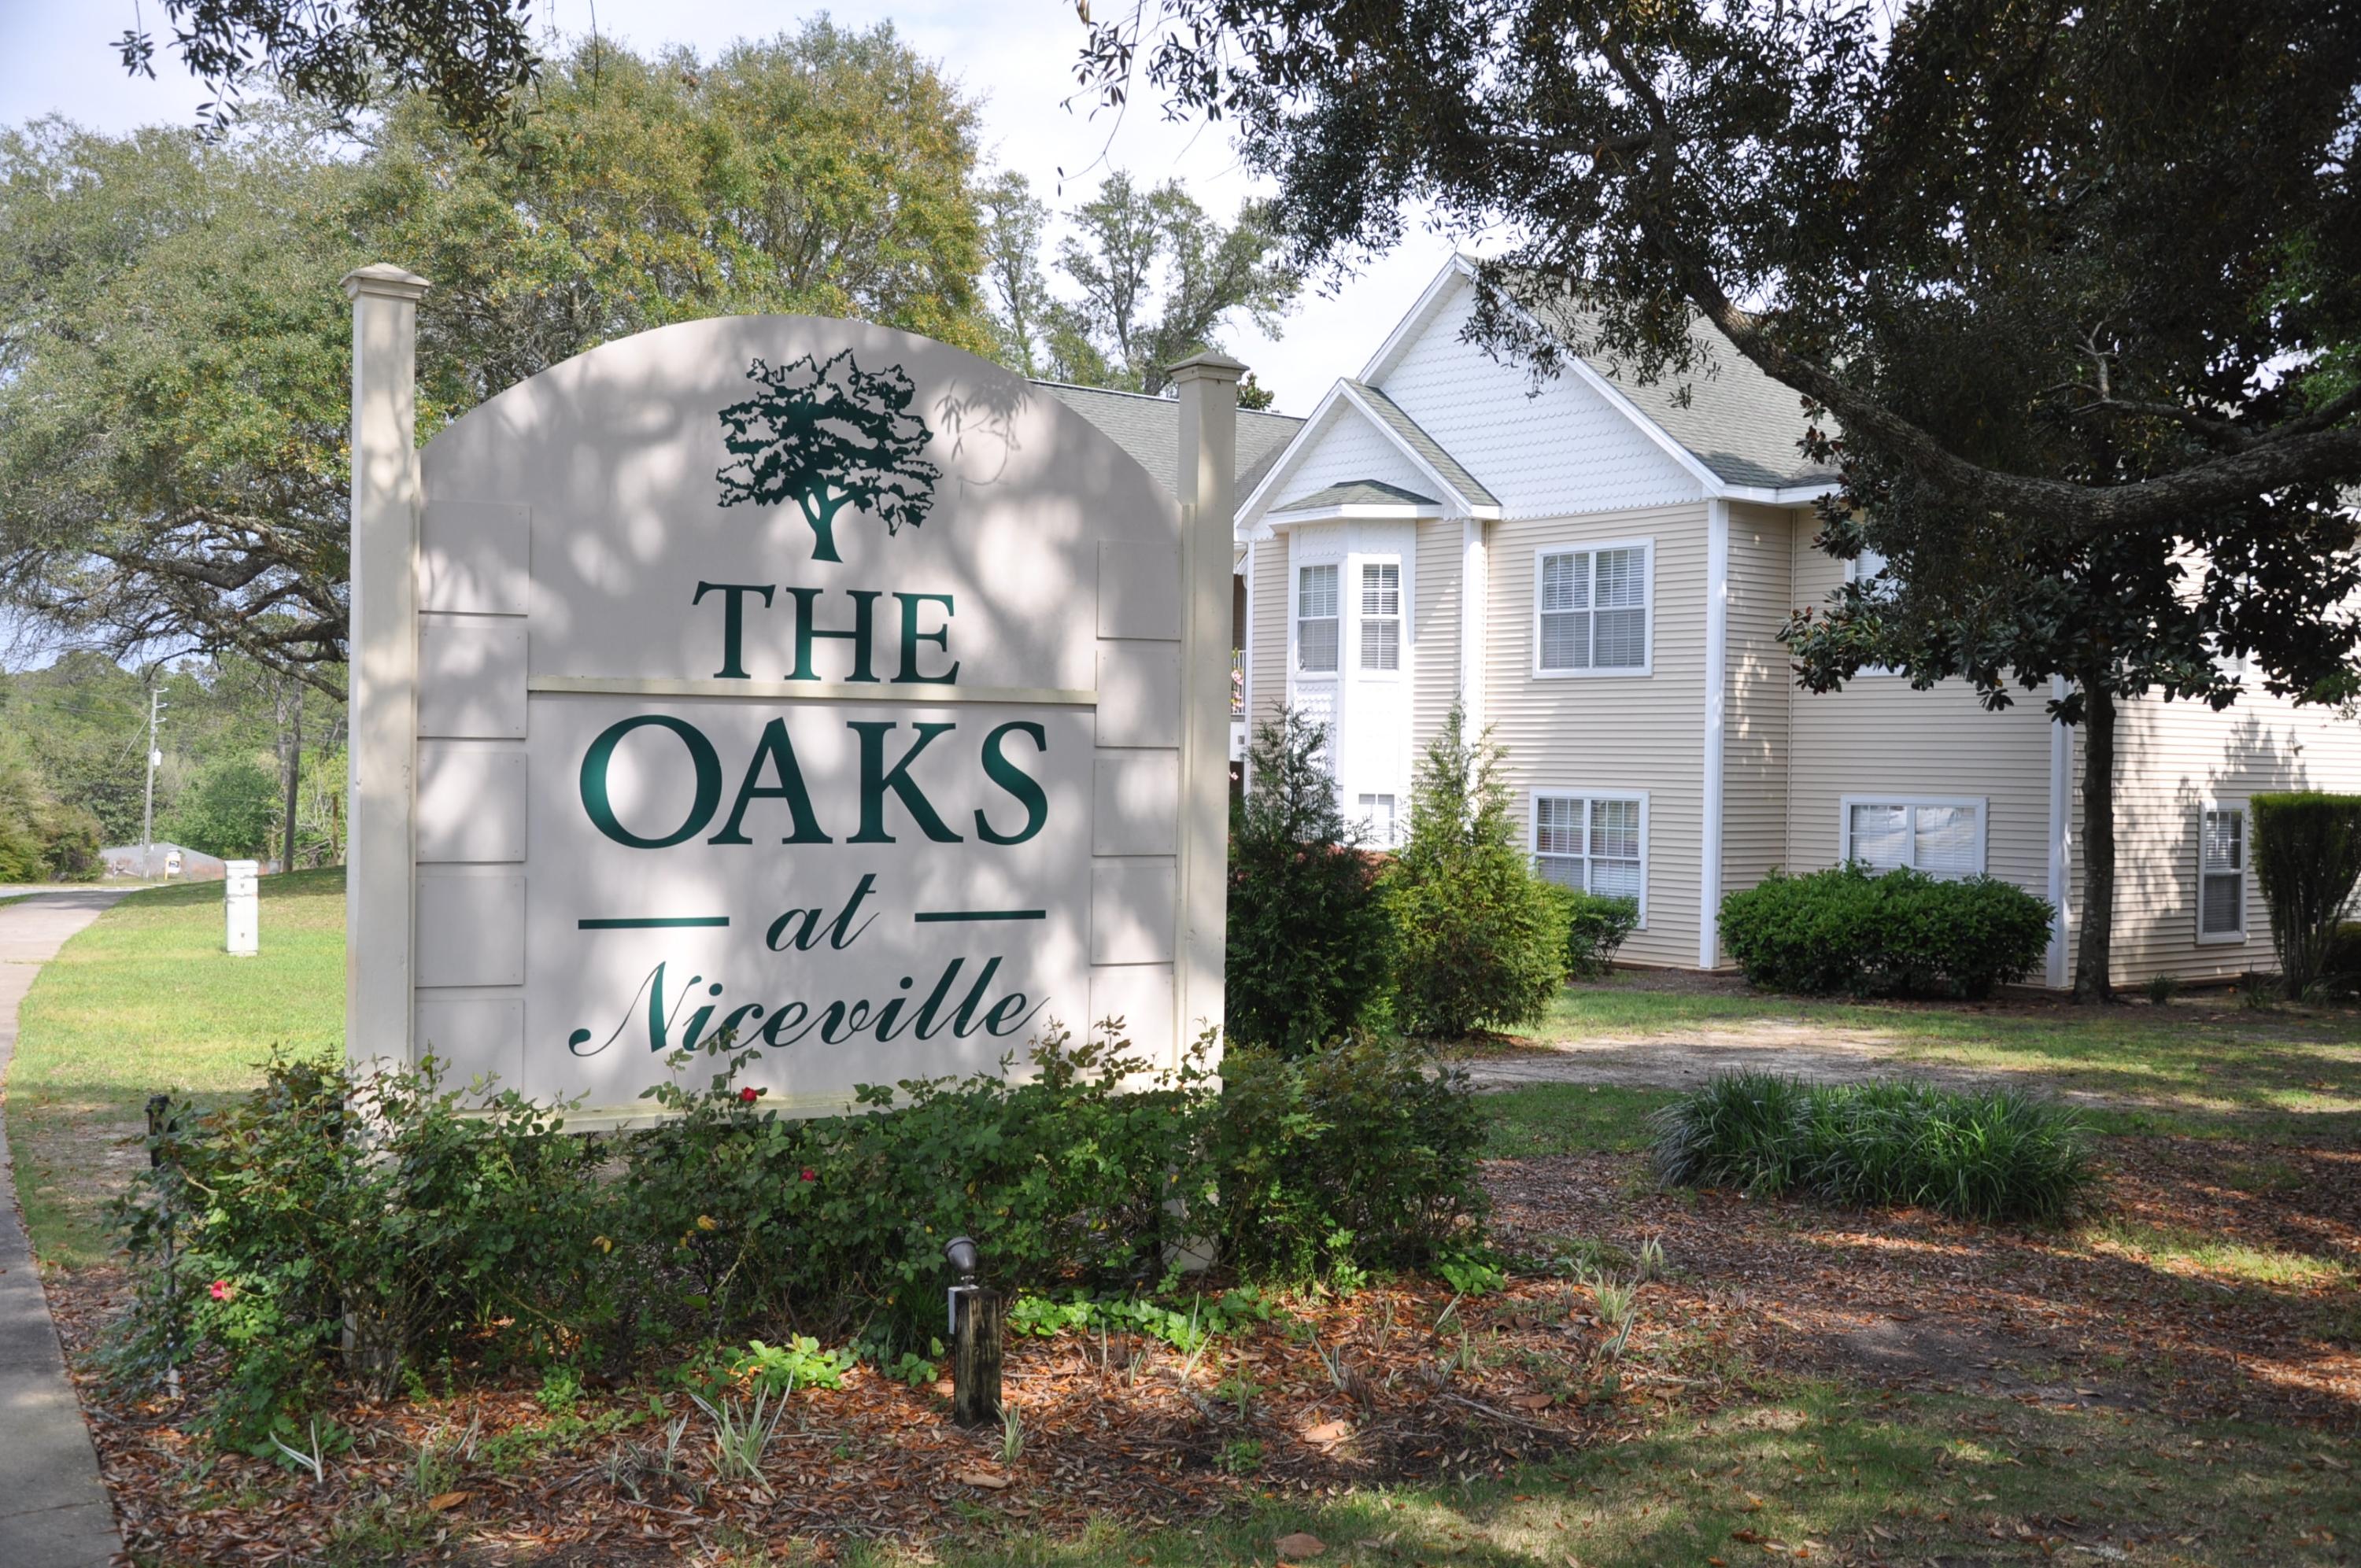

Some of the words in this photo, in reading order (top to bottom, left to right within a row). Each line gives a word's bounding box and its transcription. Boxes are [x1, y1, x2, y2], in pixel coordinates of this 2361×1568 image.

[692, 581, 960, 685] THE
[579, 714, 1048, 850] OAKS
[766, 873, 879, 952] at
[568, 955, 1049, 1057] Niceville
